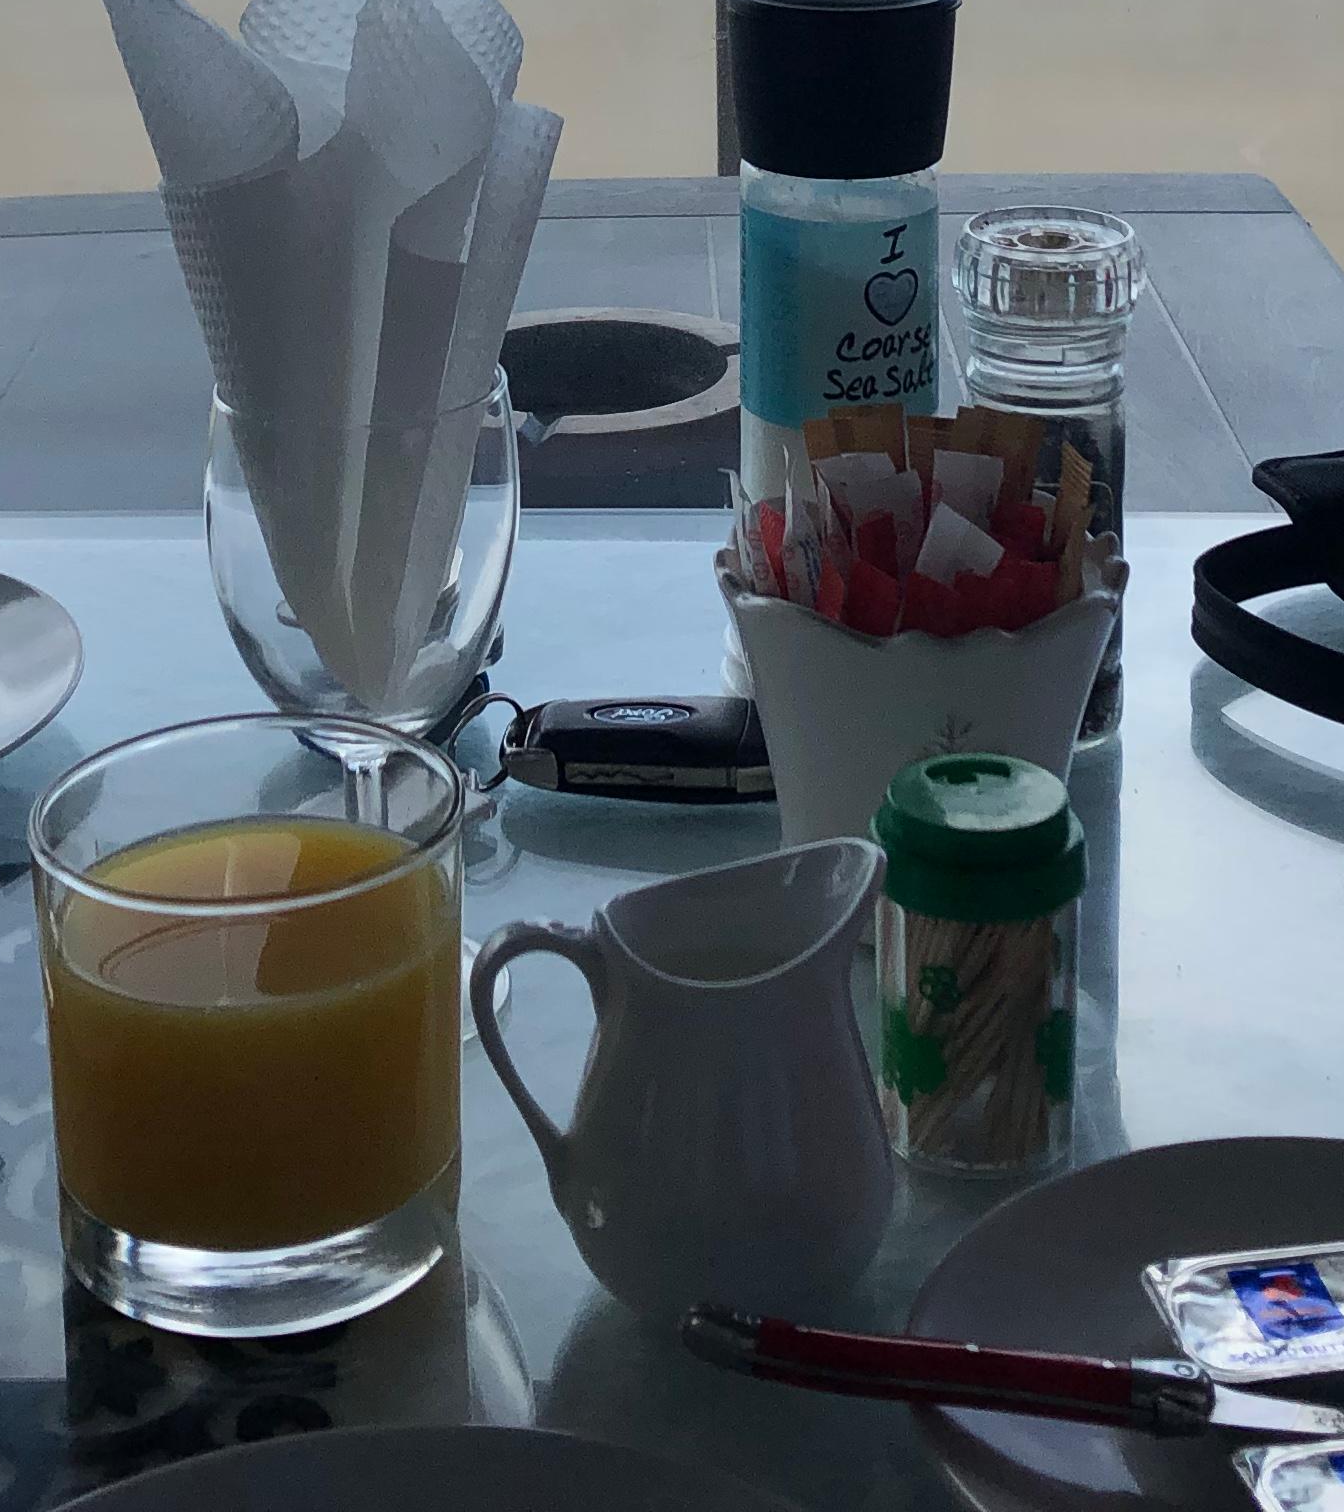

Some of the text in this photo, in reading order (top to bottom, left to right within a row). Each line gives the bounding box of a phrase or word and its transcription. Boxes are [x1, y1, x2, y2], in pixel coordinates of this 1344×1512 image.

[880, 224, 907, 264] I
[836, 323, 932, 362] Coarse
[823, 350, 934, 400] Sea Salt
[610, 707, 674, 722] Ford
